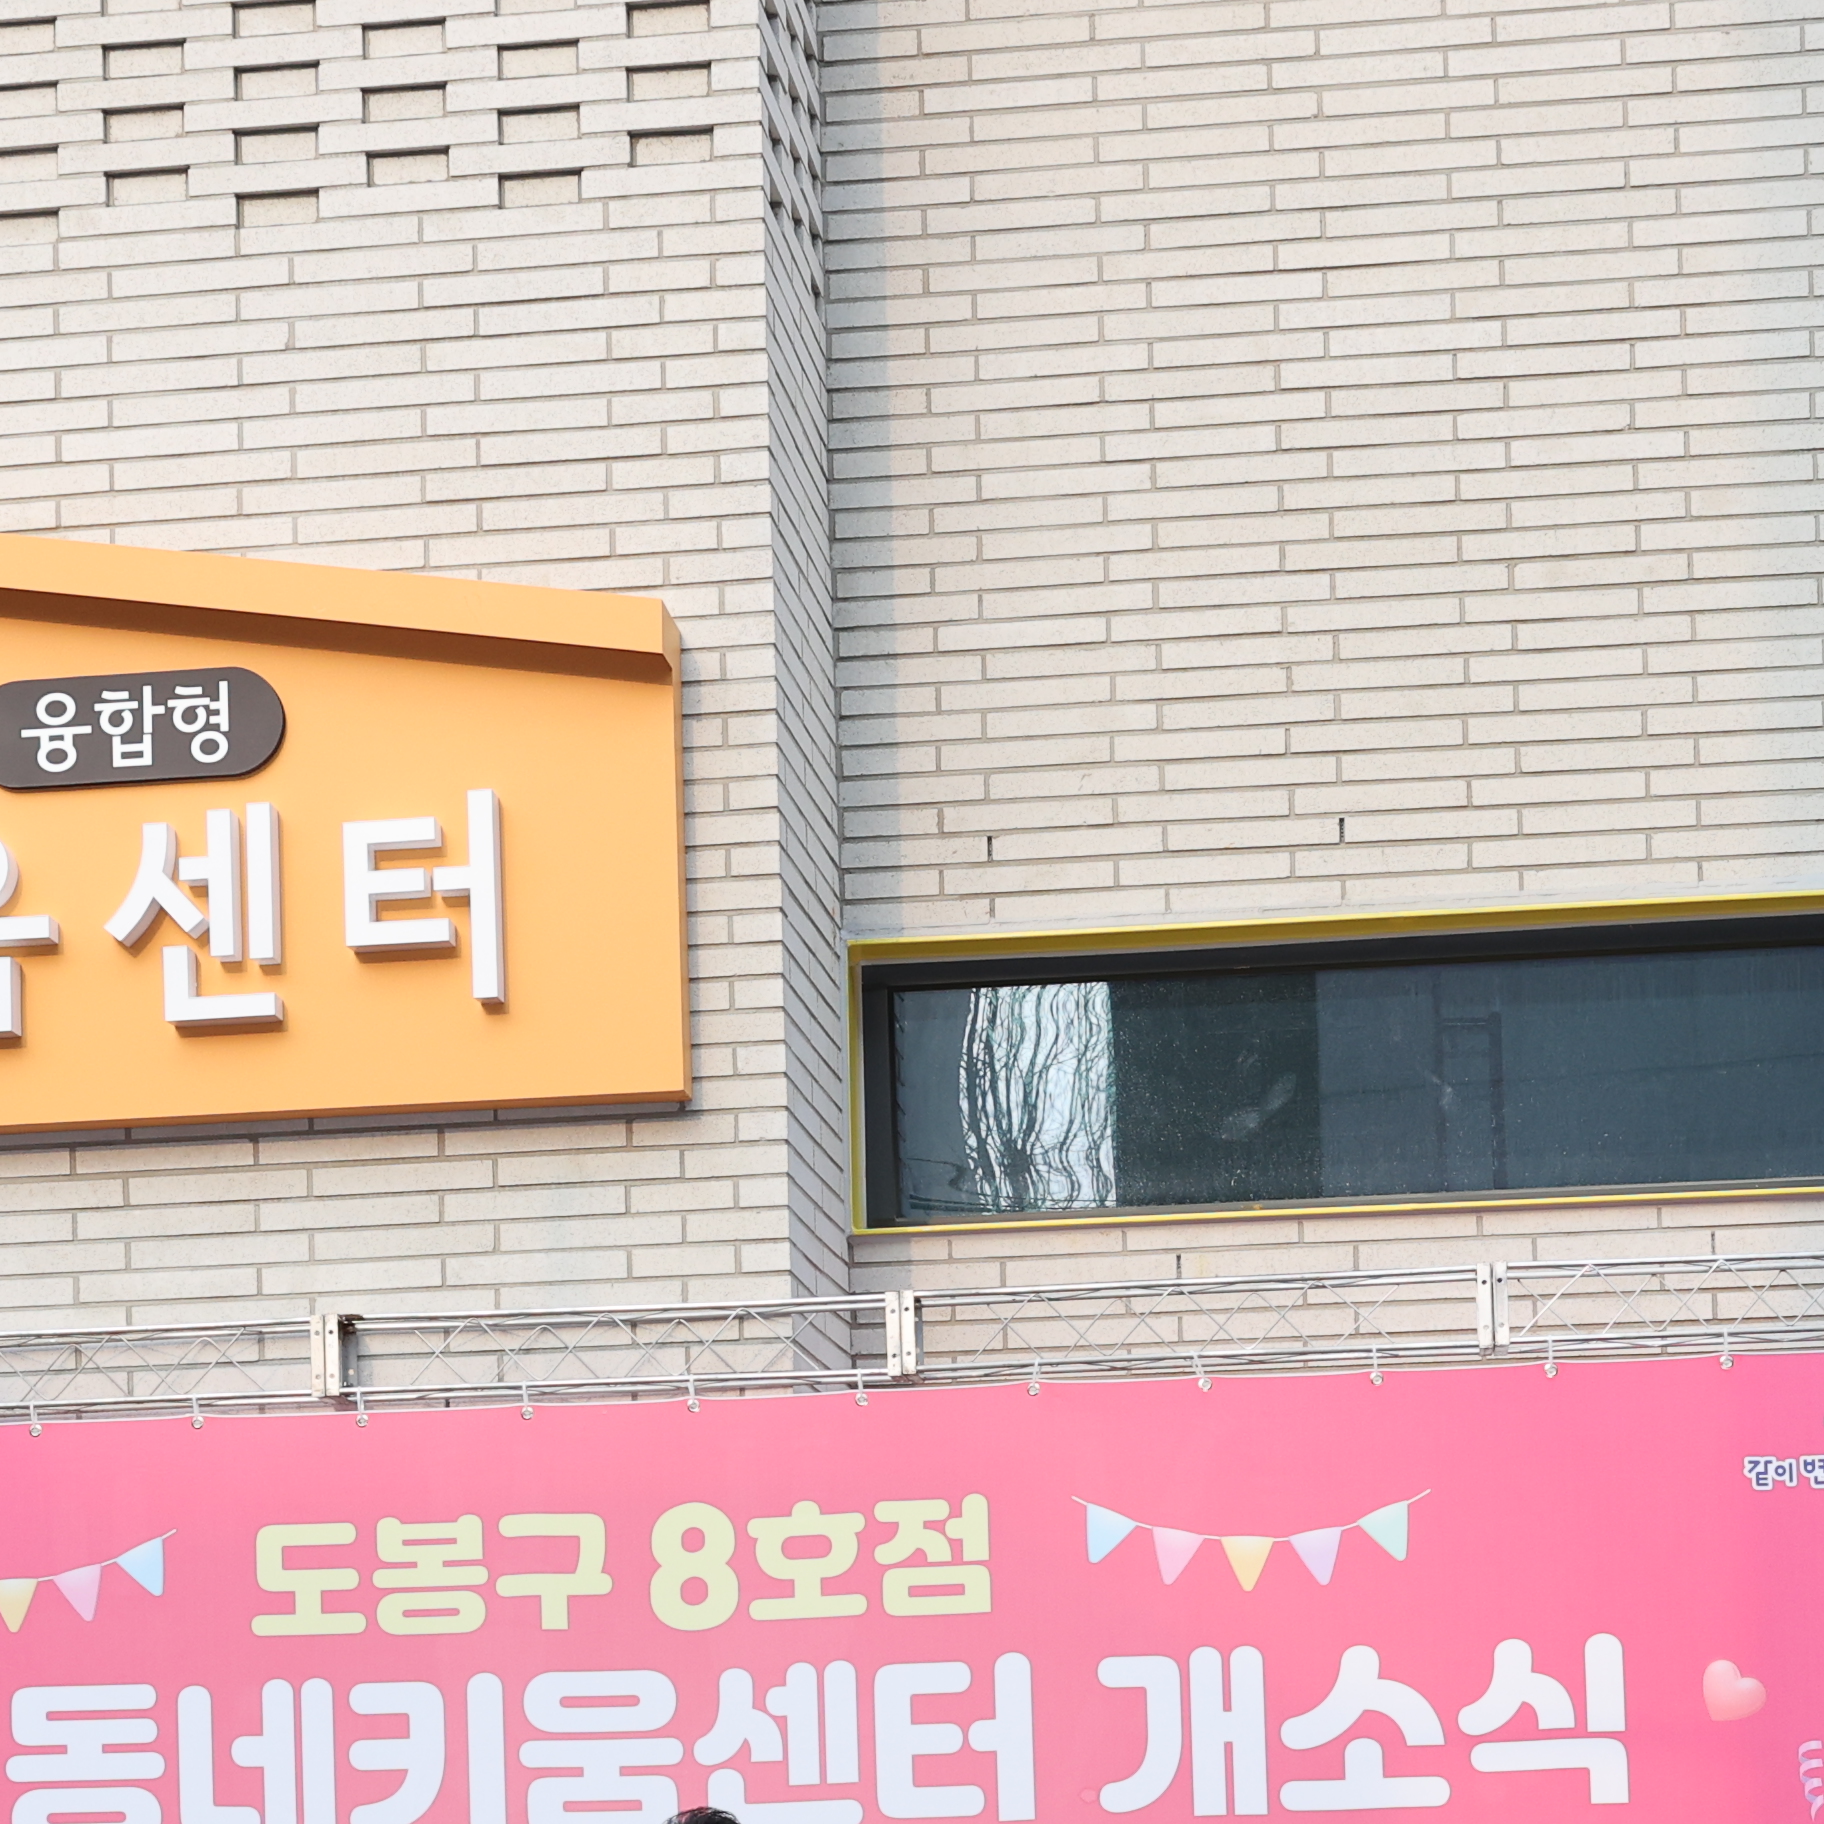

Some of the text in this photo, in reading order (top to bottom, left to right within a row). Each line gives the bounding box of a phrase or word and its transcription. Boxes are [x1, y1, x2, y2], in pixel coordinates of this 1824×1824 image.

[21, 679, 234, 774] 융합형
[1745, 1456, 1797, 1489] 같이
[251, 1493, 992, 1637] 도봉구 8호점
[1097, 1632, 1629, 1817] 개소식
